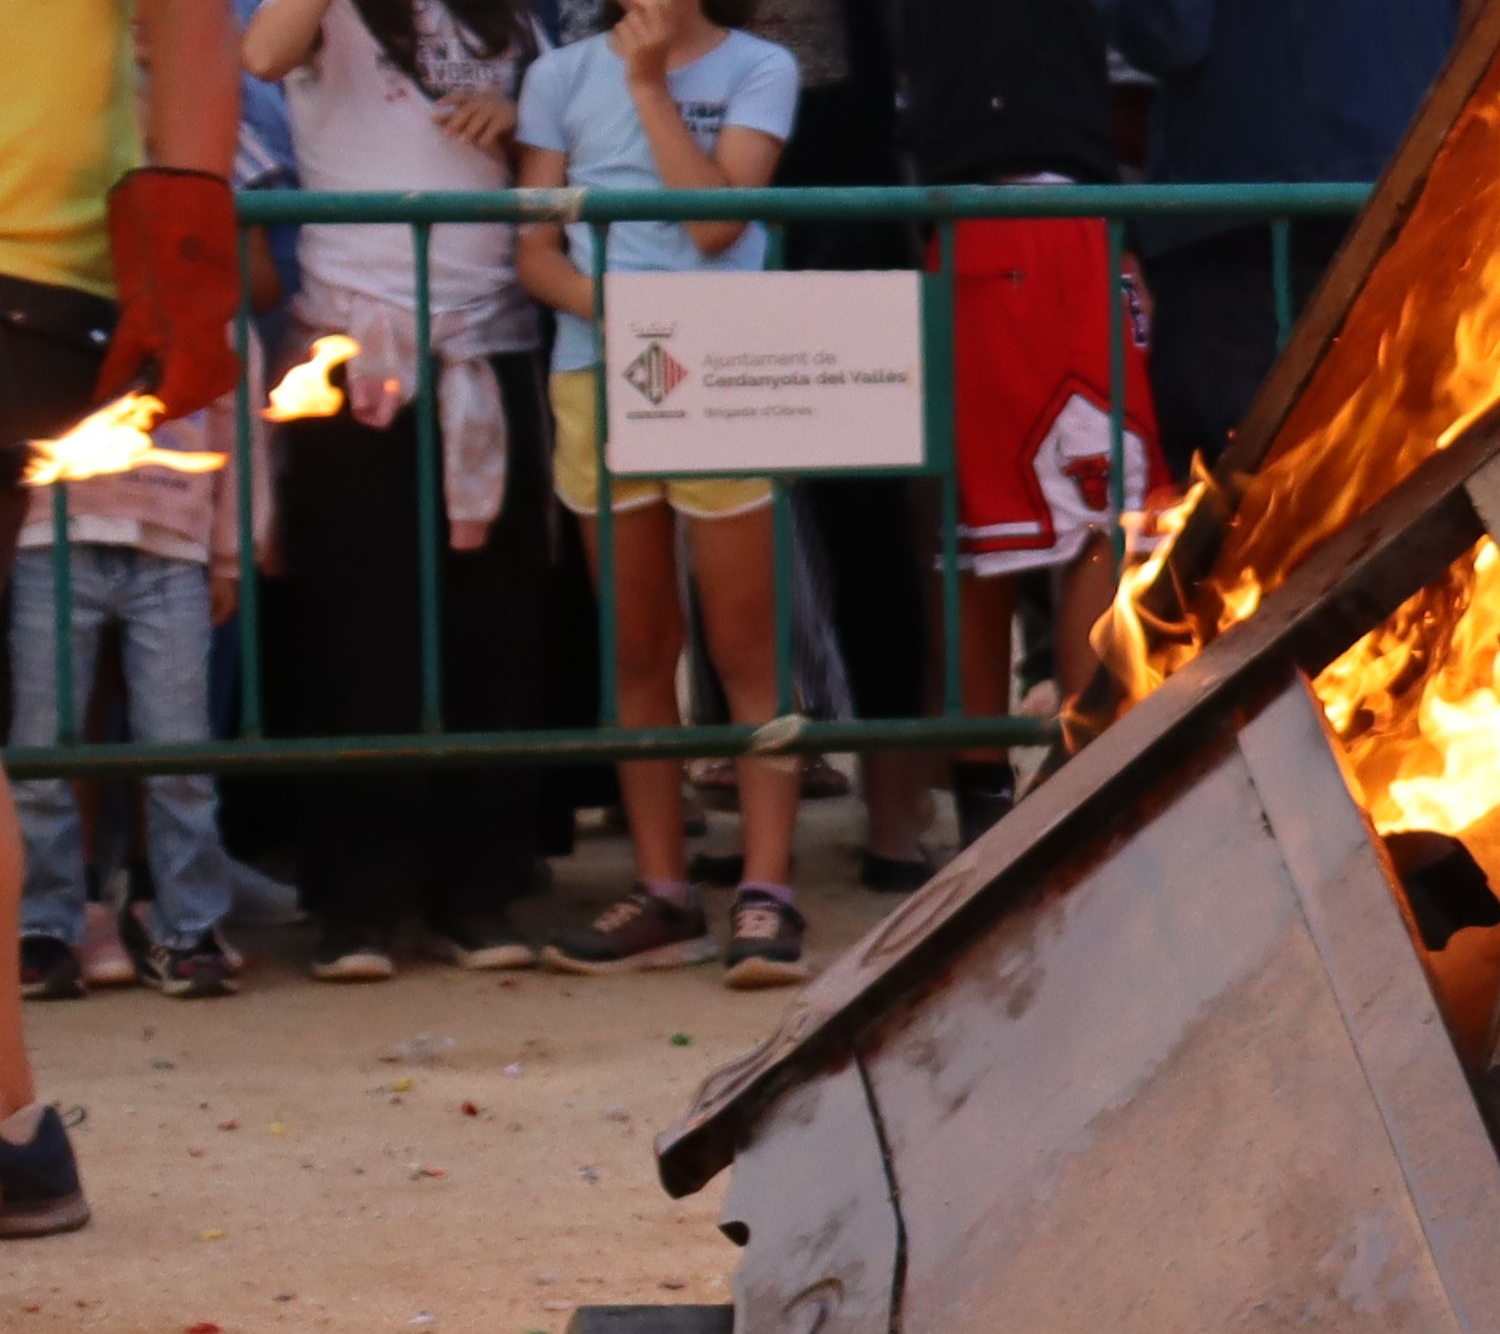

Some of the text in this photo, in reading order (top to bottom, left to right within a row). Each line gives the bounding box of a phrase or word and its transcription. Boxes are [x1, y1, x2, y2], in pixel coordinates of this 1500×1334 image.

[703, 351, 838, 370] Ajuntament de
[702, 372, 811, 390] Cerdanyola
[815, 371, 846, 385] del
